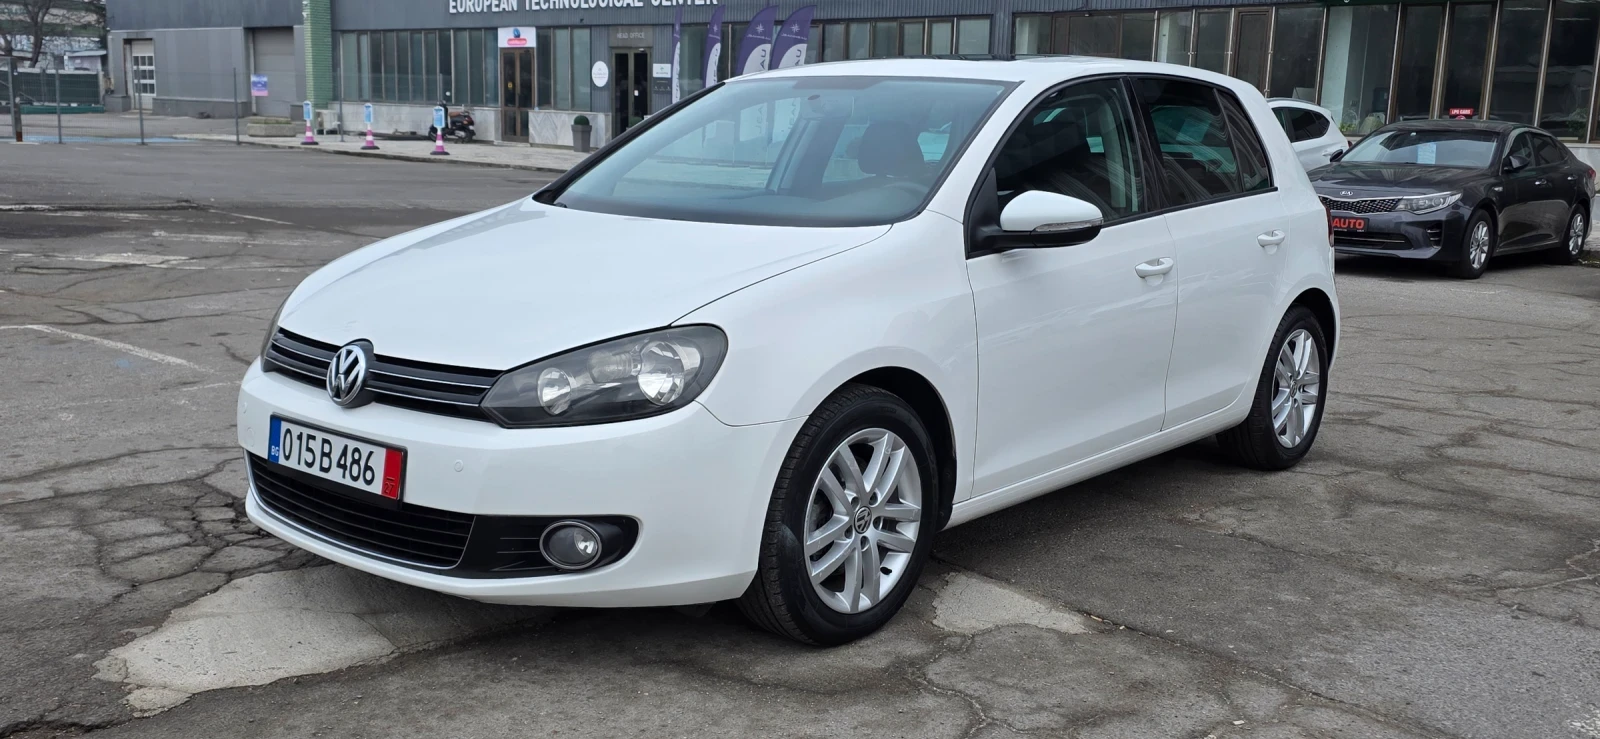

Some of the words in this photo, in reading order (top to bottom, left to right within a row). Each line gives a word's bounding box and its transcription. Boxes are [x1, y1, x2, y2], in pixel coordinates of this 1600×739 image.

[449, 0, 518, 13] EUROPEAN
[1332, 218, 1365, 229] AUTO
[271, 445, 279, 456] BG
